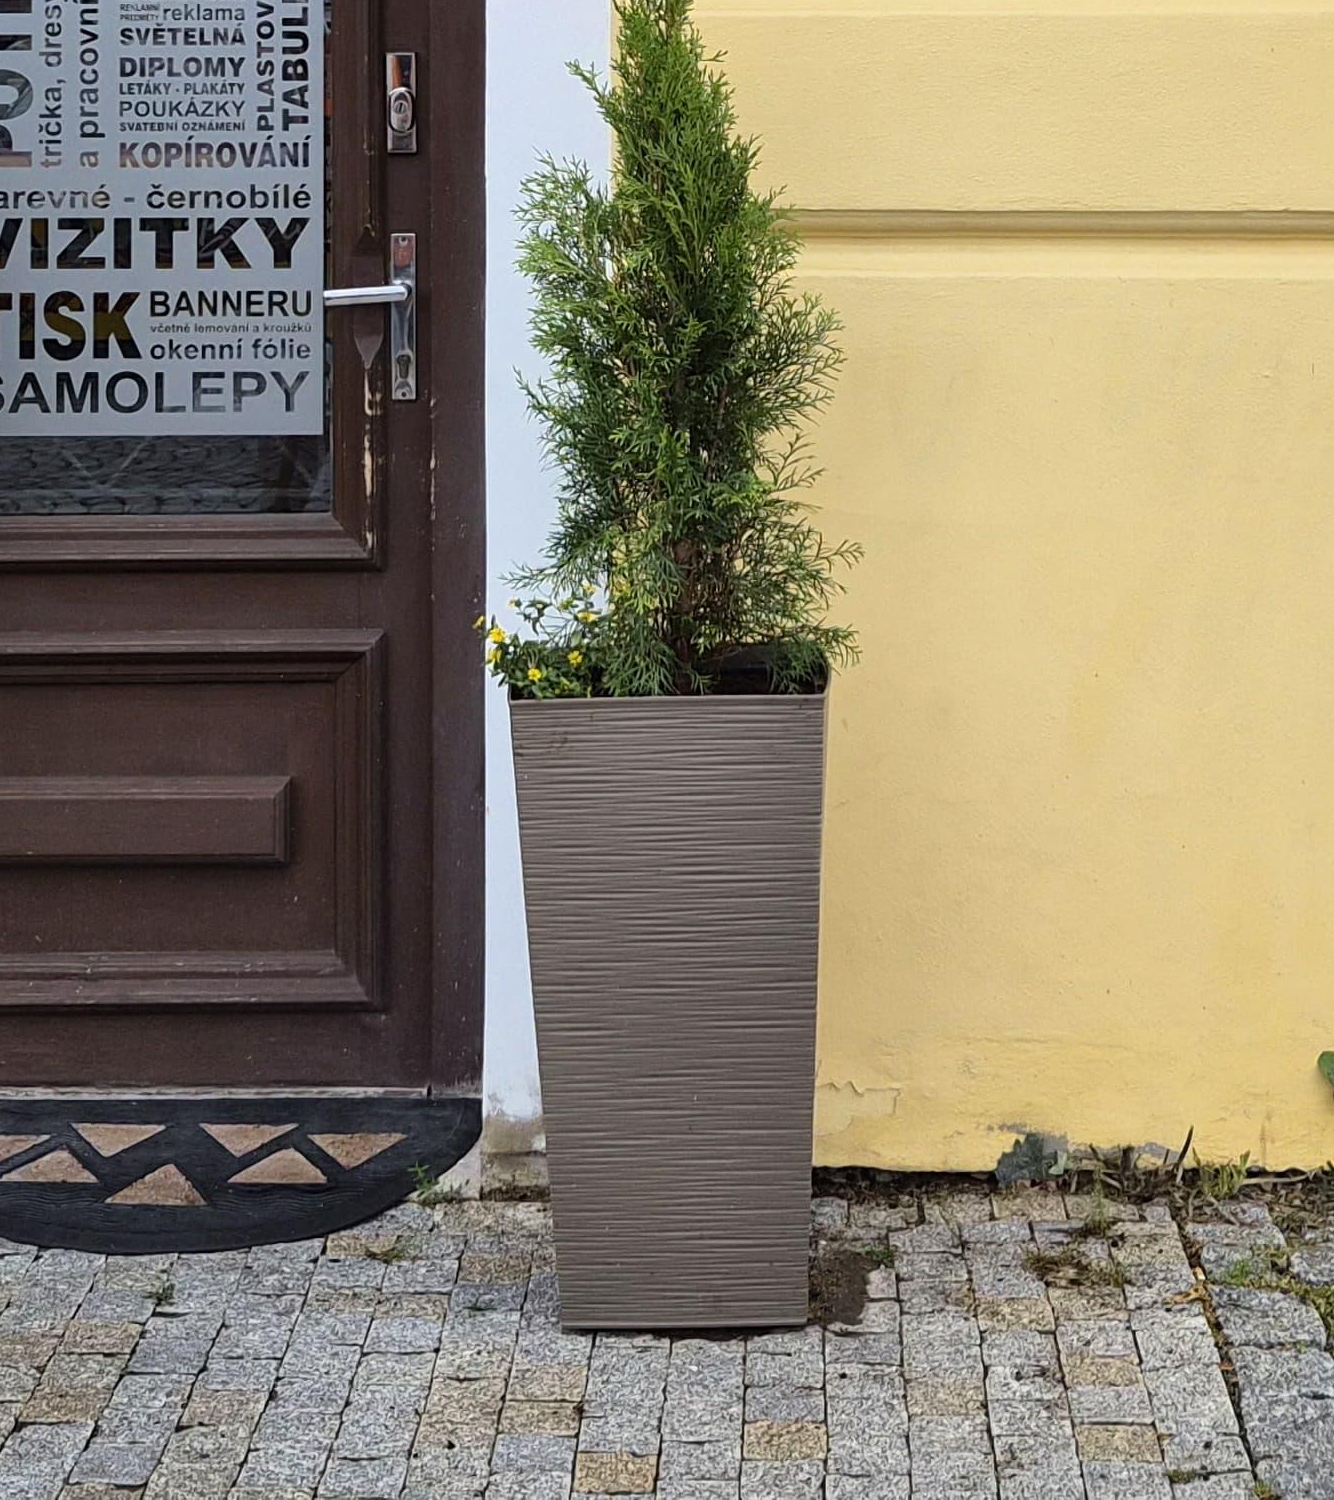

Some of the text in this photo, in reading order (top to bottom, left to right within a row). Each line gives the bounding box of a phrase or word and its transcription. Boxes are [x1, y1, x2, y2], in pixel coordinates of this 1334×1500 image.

[163, 3, 246, 21] reklama
[120, 22, 246, 46] SVĚTELNÁ
[119, 57, 246, 77] DIPLOMY
[119, 79, 171, 95] LETÁKY
[183, 80, 246, 95] PLAKÁTY
[120, 97, 246, 117] POUKÁZKY
[119, 120, 246, 132] SVATEBNÍ OZNÁMENÍ
[80, 151, 99, 168] a
[119, 135, 312, 168] KOPÍROVÁNÍ
[146, 184, 312, 209] černobílé
[149, 290, 312, 317] BANNERU
[149, 338, 311, 361] okenní fólie
